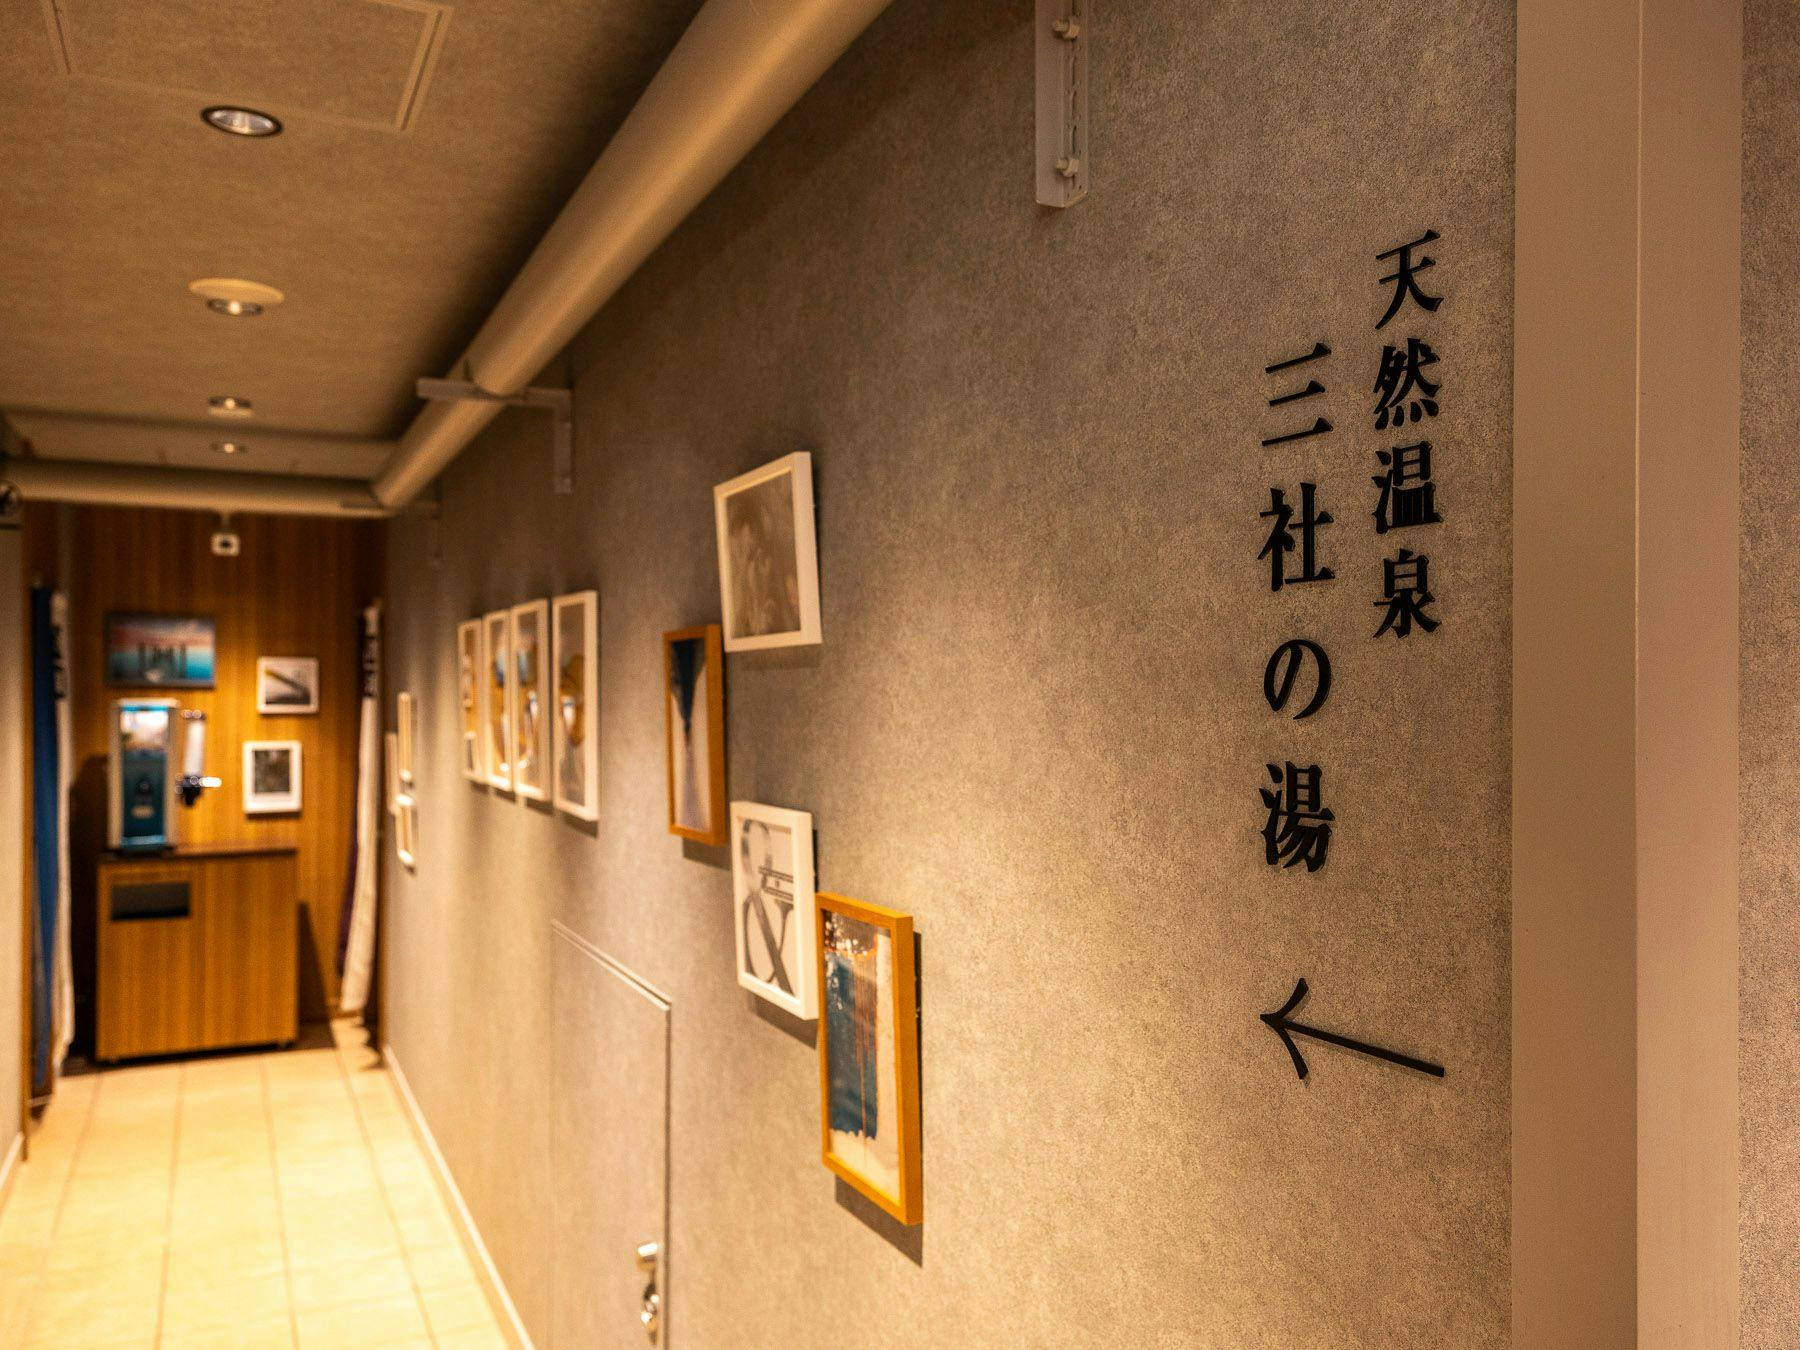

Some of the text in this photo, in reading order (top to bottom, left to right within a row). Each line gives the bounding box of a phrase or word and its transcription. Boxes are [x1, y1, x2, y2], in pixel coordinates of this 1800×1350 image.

[1258, 342, 1335, 872] 三社の湯
[1372, 229, 1443, 640] 天然温泉
